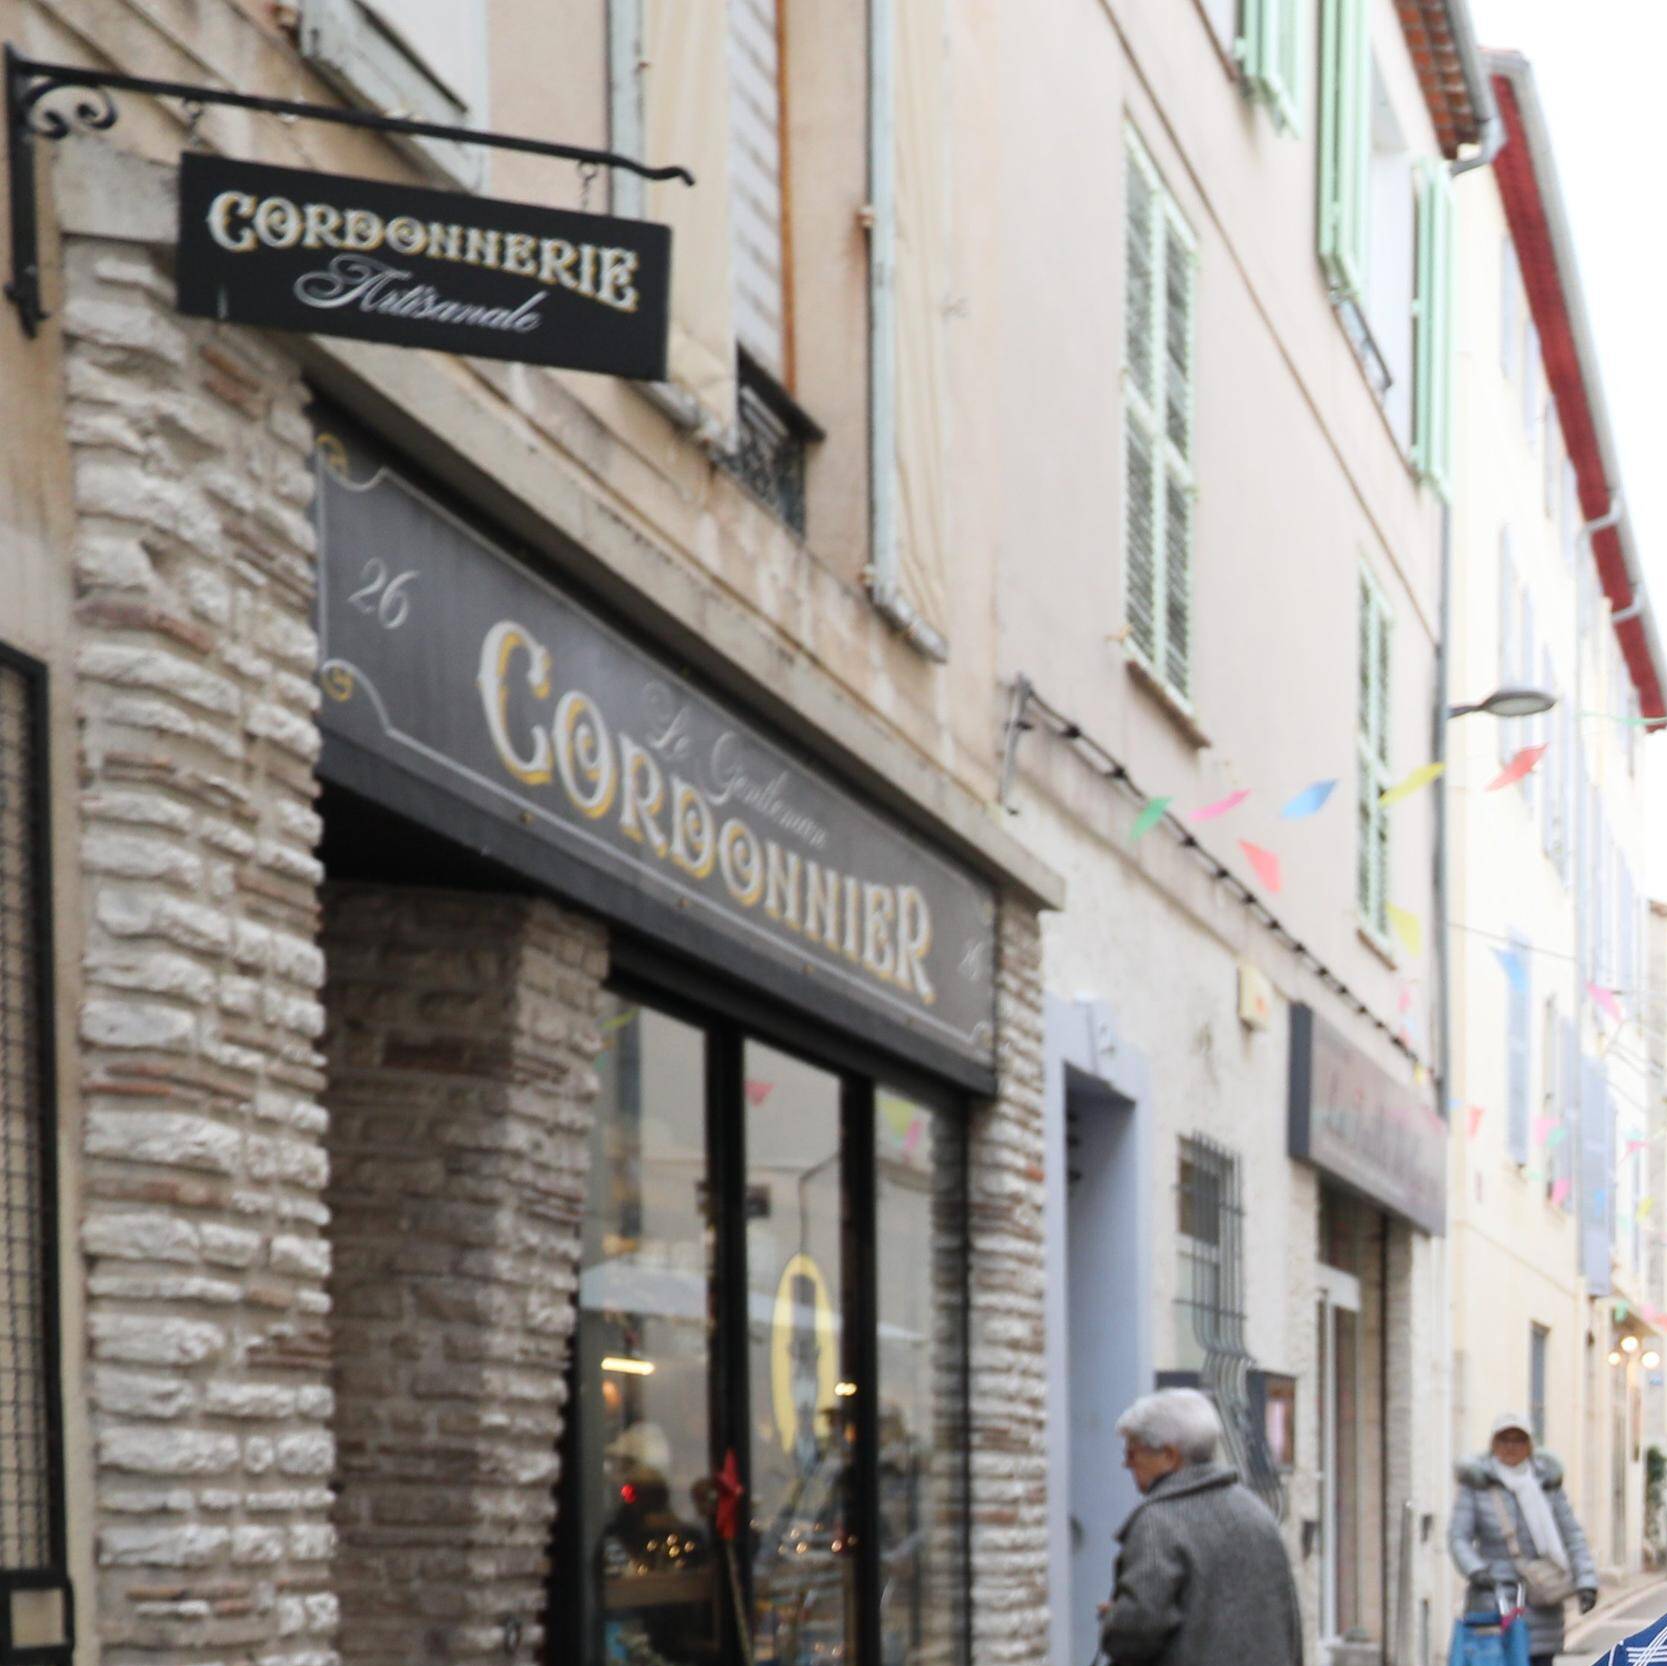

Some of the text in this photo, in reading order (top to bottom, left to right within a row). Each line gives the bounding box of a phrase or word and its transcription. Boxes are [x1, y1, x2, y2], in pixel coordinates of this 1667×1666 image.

[207, 191, 638, 312] CORDONNERIE
[294, 253, 549, 333] Artisanale
[347, 556, 420, 629] 26
[478, 621, 937, 1004] CORDONNIER
